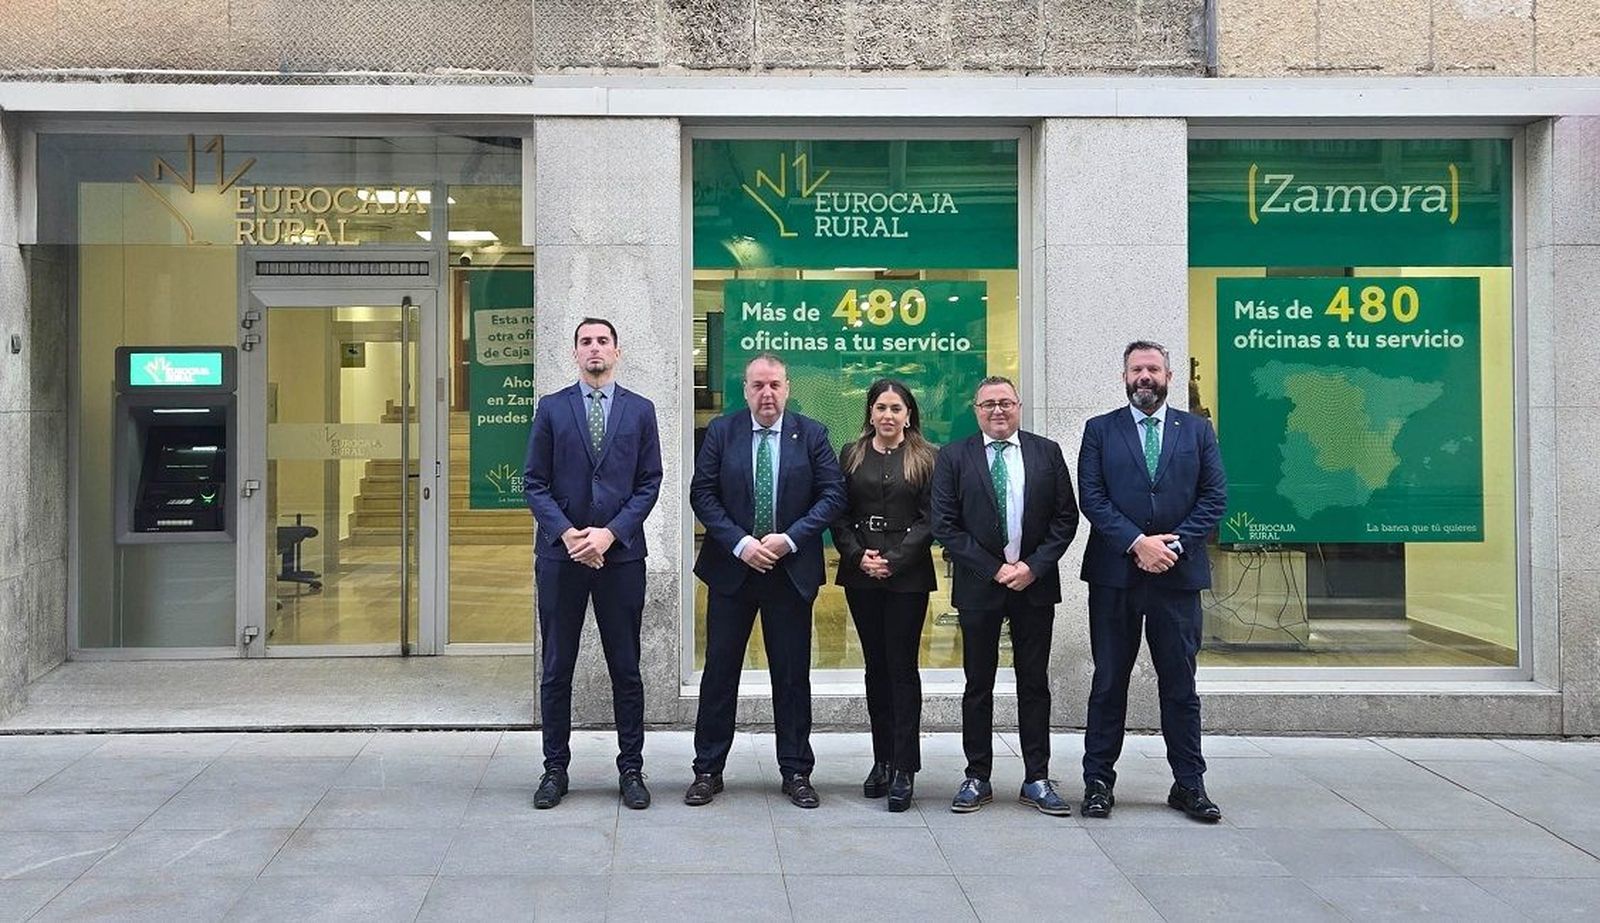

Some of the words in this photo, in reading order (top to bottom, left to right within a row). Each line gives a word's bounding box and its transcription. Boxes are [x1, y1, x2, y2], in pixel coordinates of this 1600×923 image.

[234, 185, 427, 214] EUROCAJA
[814, 192, 959, 214] EUROCAJA
[234, 218, 361, 246] RURAL
[814, 216, 908, 238] RURAL
[741, 301, 789, 322] Más
[793, 301, 820, 322] de
[831, 288, 927, 326] 480
[1234, 300, 1280, 320] Más
[1285, 299, 1313, 320] de
[1324, 286, 1420, 323] 480
[491, 314, 518, 325] Esta
[488, 332, 514, 342] otra
[740, 330, 829, 352] oficinas
[834, 337, 847, 352] a
[852, 334, 876, 352] tu
[882, 331, 971, 352] servicio
[1233, 329, 1322, 349] oficinas
[1327, 335, 1341, 349] a
[1345, 331, 1370, 349] tu
[1375, 329, 1465, 349] servicio
[483, 348, 500, 359] de
[503, 346, 531, 360] Caja
[486, 397, 504, 406] en
[477, 411, 528, 427] puedes
[1248, 523, 1296, 532] EUROCAJA
[1248, 532, 1281, 540] RURAL
[1366, 523, 1379, 532] La
[1381, 523, 1410, 532] banca
[1411, 524, 1430, 534] que
[1443, 523, 1477, 534] quieres
